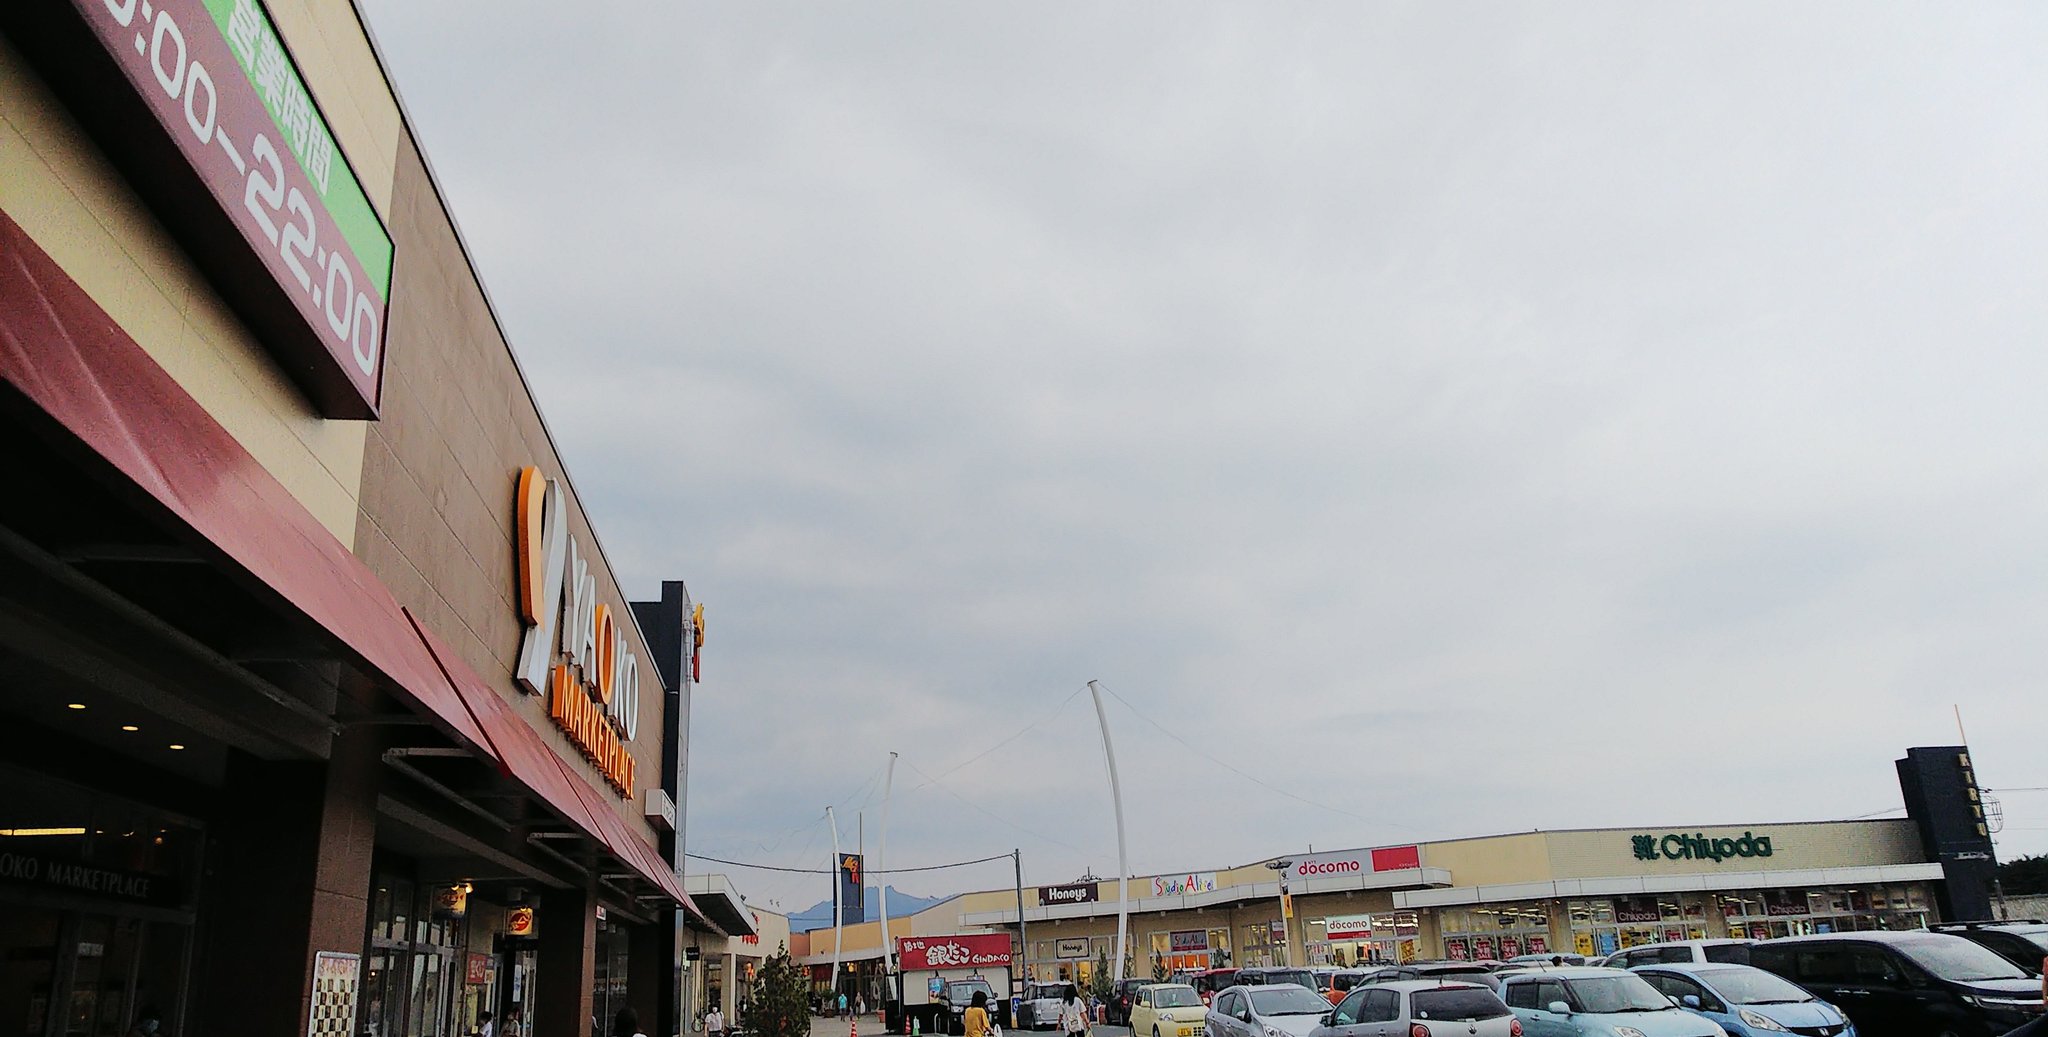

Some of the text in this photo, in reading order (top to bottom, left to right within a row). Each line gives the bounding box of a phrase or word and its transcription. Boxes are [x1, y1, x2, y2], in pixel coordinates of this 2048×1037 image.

[560, 532, 640, 743] YAOKO
[551, 664, 636, 801] MARKETPLACE
[1957, 752, 1987, 836] KIRYU
[1661, 831, 1773, 863] Chiyoda
[47, 861, 152, 899] MARKETPLACE
[1298, 861, 1360, 875] docomo
[1048, 888, 1087, 902] Honeys
[1329, 920, 1368, 930] docomo
[1618, 911, 1658, 922] Chiyoda
[926, 939, 971, 966] 銀だこ
[1063, 944, 1083, 953] Honeys
